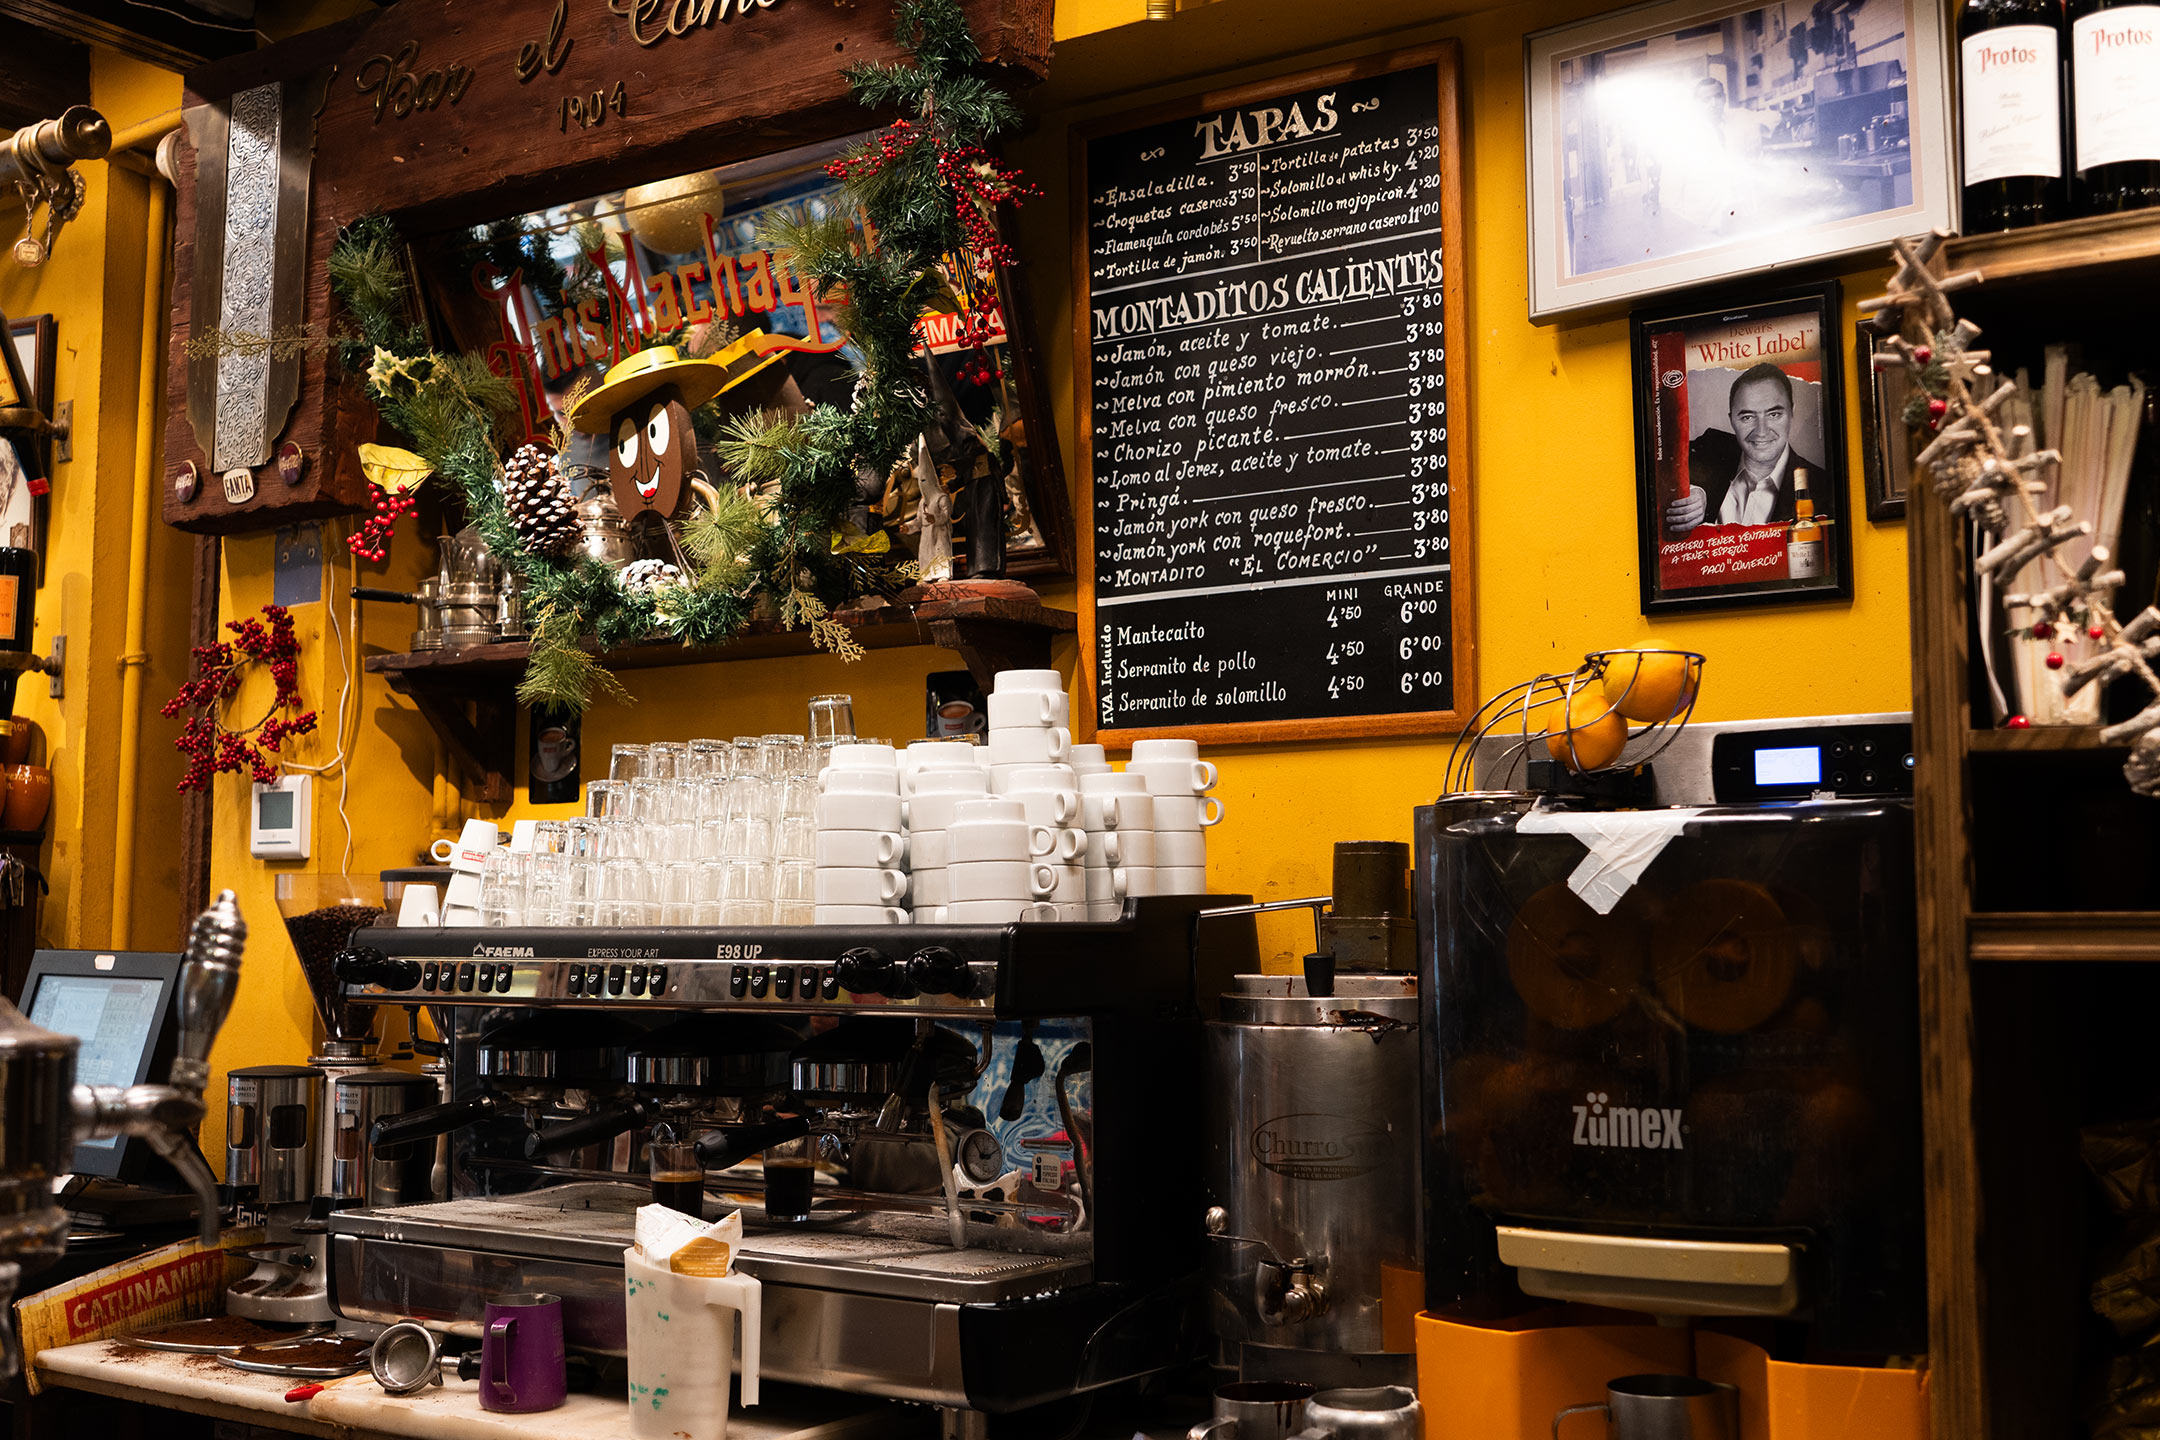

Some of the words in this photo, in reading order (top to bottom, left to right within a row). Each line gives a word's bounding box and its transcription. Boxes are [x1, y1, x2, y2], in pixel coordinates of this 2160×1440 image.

[514, 0, 574, 83] el
[2091, 28, 2153, 56] Protos
[1977, 46, 2037, 74] Protos
[557, 80, 627, 135] 1904
[1194, 92, 1338, 159] TAPAS
[1272, 151, 1326, 173] Tortilla
[1329, 152, 1338, 162] de
[1340, 138, 1399, 168] patatas
[1270, 173, 1334, 198] Solomillo
[1336, 173, 1345, 184] al
[1107, 207, 1172, 233] Croquetas
[1180, 197, 1228, 214] caseras
[1270, 200, 1333, 223] Solomillo
[1105, 229, 1173, 255] Flamenquín
[1177, 219, 1229, 241] cordobés
[1269, 228, 1319, 253] Revuelto
[1320, 222, 1367, 240] serrano
[1369, 214, 1407, 230] casero
[1107, 258, 1159, 279] Tortilla
[1164, 256, 1176, 267] de
[1093, 274, 1289, 338] MONTADITOS
[1295, 248, 1443, 305] CALIENTES
[1180, 328, 1229, 351] aceite
[1240, 330, 1249, 345] y
[1729, 322, 1773, 338] Dewar's
[1110, 371, 1164, 388] Jamón
[1175, 364, 1200, 380] con
[1208, 355, 1257, 384] queso
[1112, 395, 1161, 413] Melva
[1167, 390, 1195, 405] con
[1202, 373, 1285, 410] pimiento
[1110, 419, 1161, 438] Melva
[1169, 415, 1196, 430] con
[1206, 405, 1257, 435] queso
[1115, 439, 1181, 462] Chorizo
[1110, 470, 1150, 489] Lomo
[1155, 462, 1170, 482] al
[1231, 449, 1281, 472] aceite
[1285, 453, 1298, 473] y
[225, 474, 252, 498] FANTA
[1114, 519, 1164, 536] Jamón
[1167, 510, 1209, 539] york
[1215, 512, 1242, 525] con
[1249, 504, 1297, 532] queso
[1113, 538, 1166, 561] Jamón
[1167, 537, 1205, 563] york
[1213, 536, 1241, 551] con
[1706, 535, 1735, 550] TENER
[1738, 528, 1782, 543] VENTANAS
[1671, 556, 1679, 565] A
[1681, 550, 1710, 563] TENER
[1700, 562, 1725, 576] PACO
[1115, 565, 1204, 587] MONTADITO
[1327, 588, 1357, 601] MINI
[1385, 581, 1443, 599] GRANDE
[1101, 625, 1112, 685] Incluido
[1118, 657, 1186, 678] Serranito
[1193, 655, 1209, 672] de
[1218, 651, 1255, 678] pollo
[1119, 689, 1186, 711] Serranito
[1192, 688, 1206, 706] de
[1216, 681, 1286, 705] solomillo
[485, 946, 534, 958] FAEMA
[587, 948, 619, 959] EXPRESS
[620, 948, 641, 959] YOUR
[643, 948, 660, 958] ART
[716, 944, 741, 960] E98
[743, 944, 763, 959] UP
[1255, 1130, 1339, 1156] Churro
